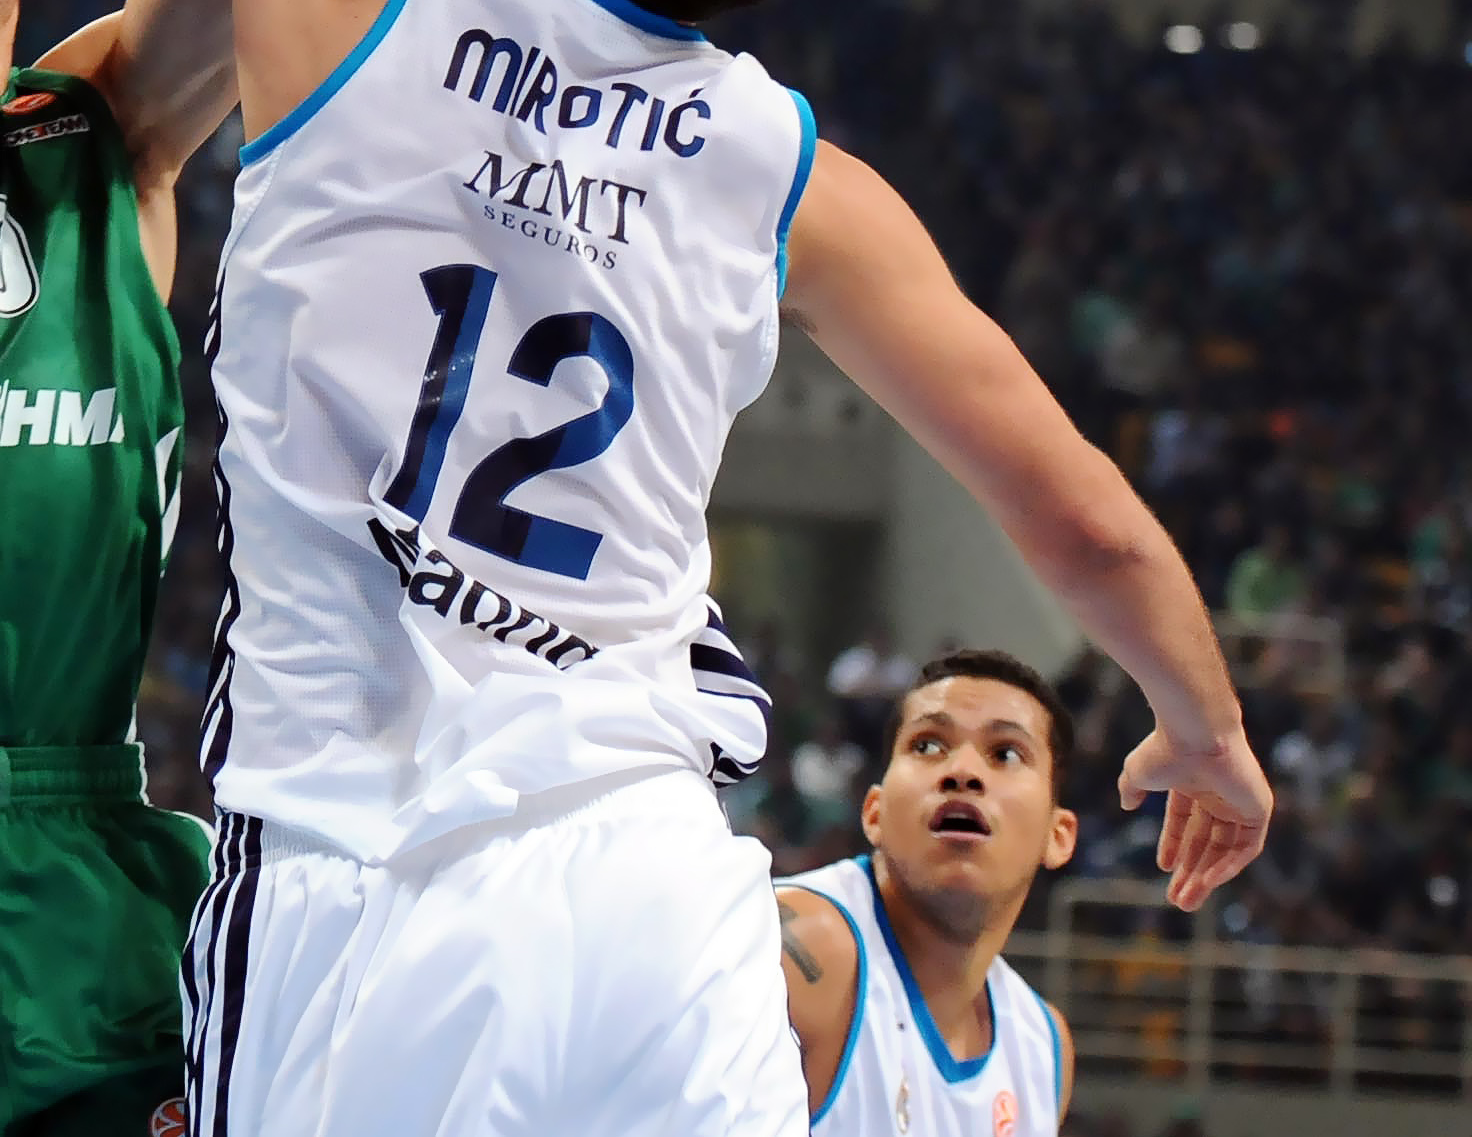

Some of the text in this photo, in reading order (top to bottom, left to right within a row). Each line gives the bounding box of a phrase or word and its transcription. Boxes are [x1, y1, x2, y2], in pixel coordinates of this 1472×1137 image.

[444, 29, 711, 158] MIROTIĆ
[463, 150, 647, 245] MMT
[484, 205, 617, 270] SEGUROS
[383, 264, 634, 581] 12
